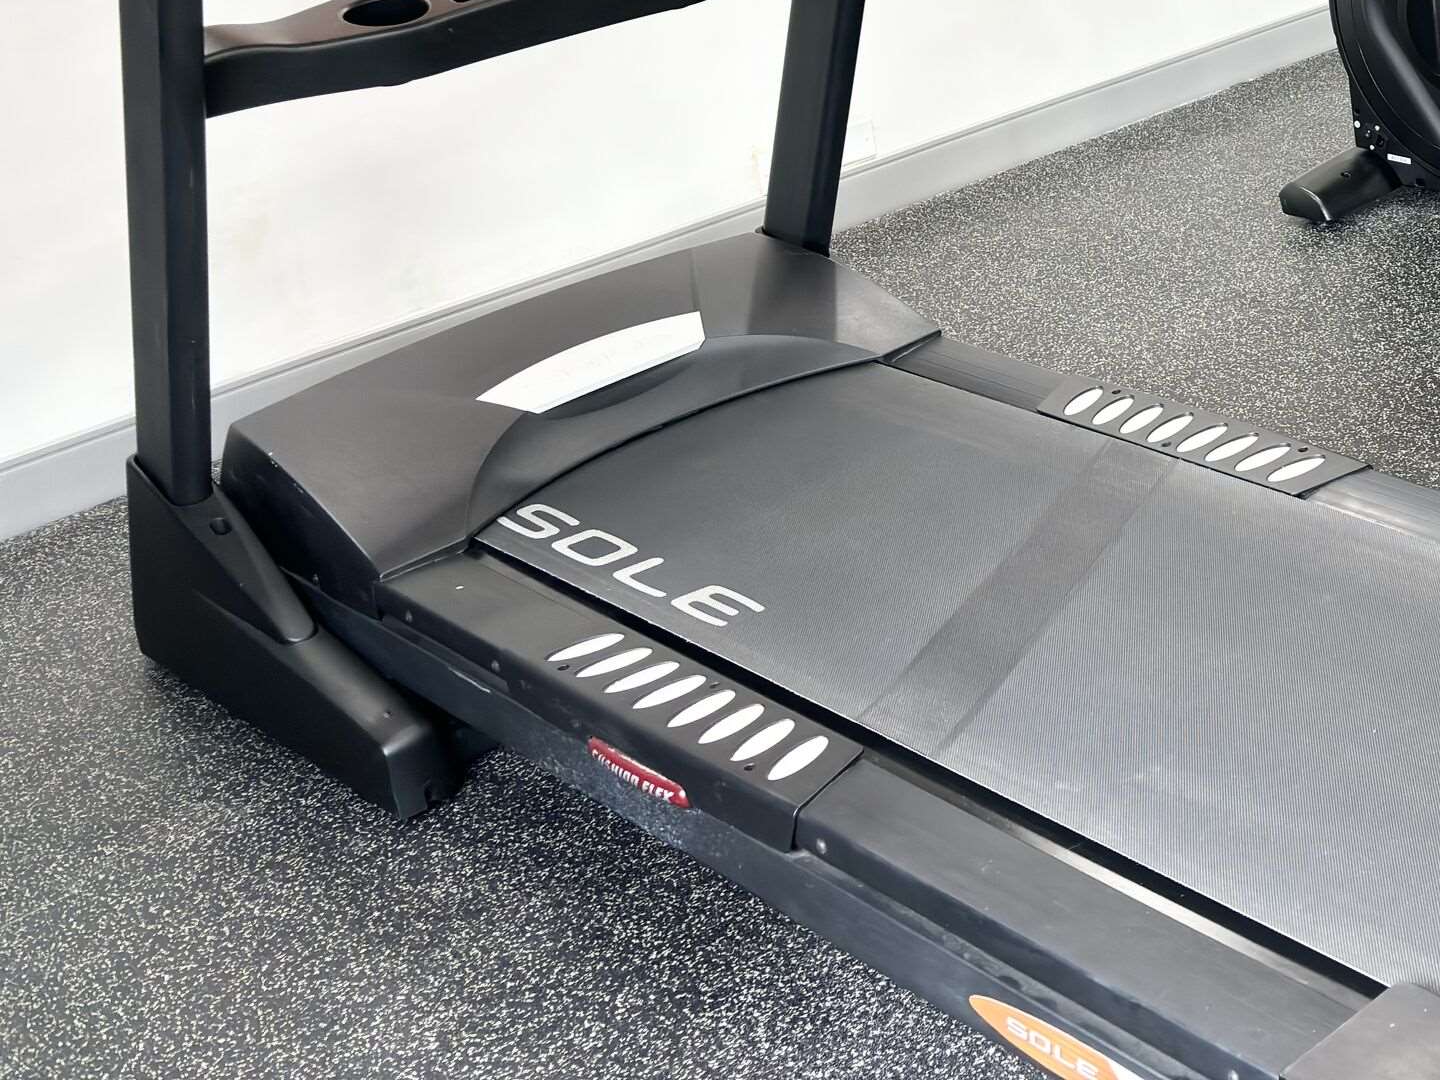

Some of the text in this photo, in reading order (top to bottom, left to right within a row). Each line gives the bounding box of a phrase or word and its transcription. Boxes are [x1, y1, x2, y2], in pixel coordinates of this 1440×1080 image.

[496, 503, 766, 627] SOLE
[591, 748, 675, 804] CUSHION FLEX
[1006, 1015, 1099, 1078] SOLE
